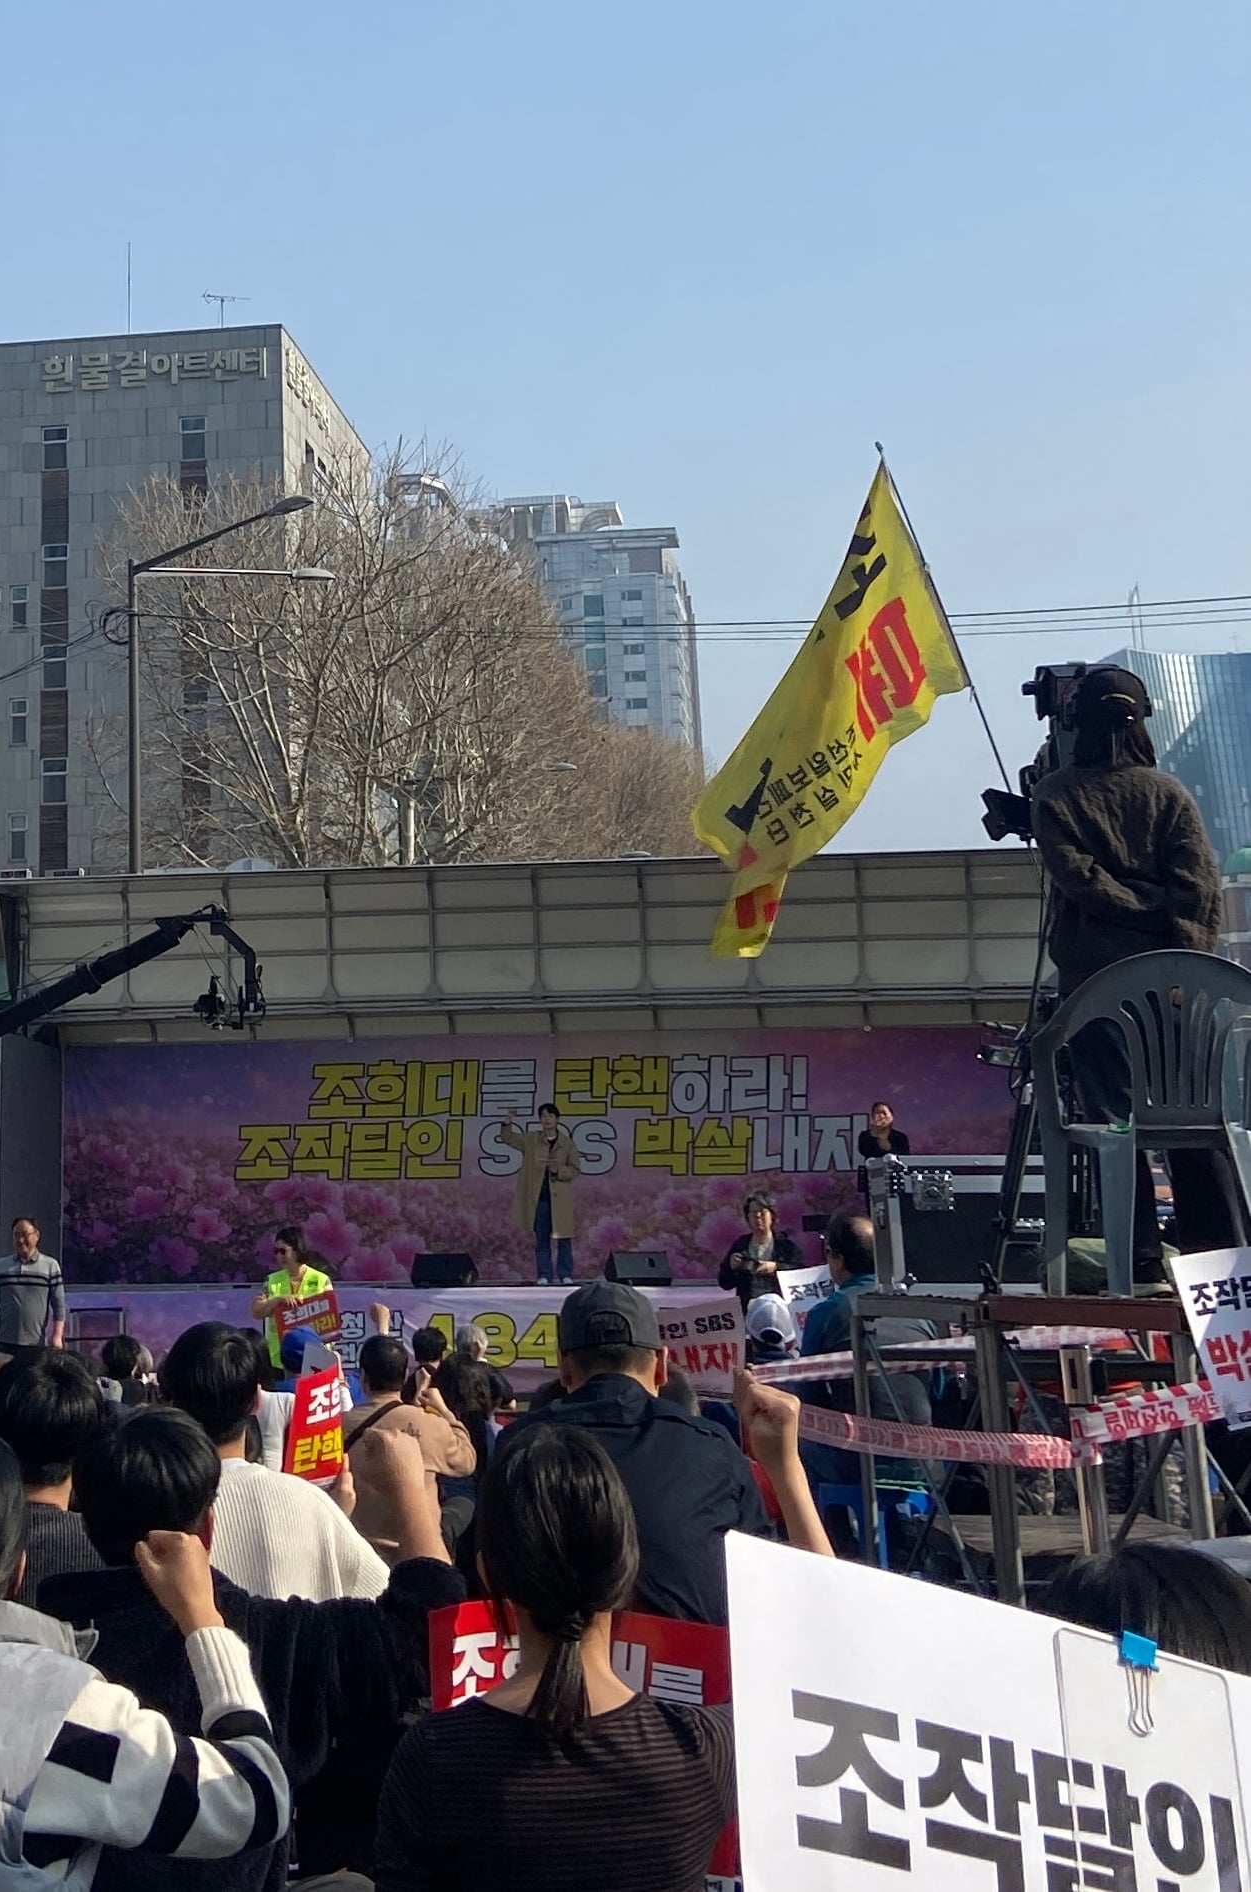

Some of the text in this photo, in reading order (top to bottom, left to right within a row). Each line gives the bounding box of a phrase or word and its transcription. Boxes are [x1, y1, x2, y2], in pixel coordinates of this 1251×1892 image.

[41, 346, 269, 394] 흰물결아트센터
[307, 1054, 810, 1119] 조희대를 탄핵하라!
[234, 1119, 464, 1181] 조작달인
[478, 1119, 618, 1177] SS
[282, 1298, 331, 1326] 조희대를
[694, 1312, 736, 1335] SBS
